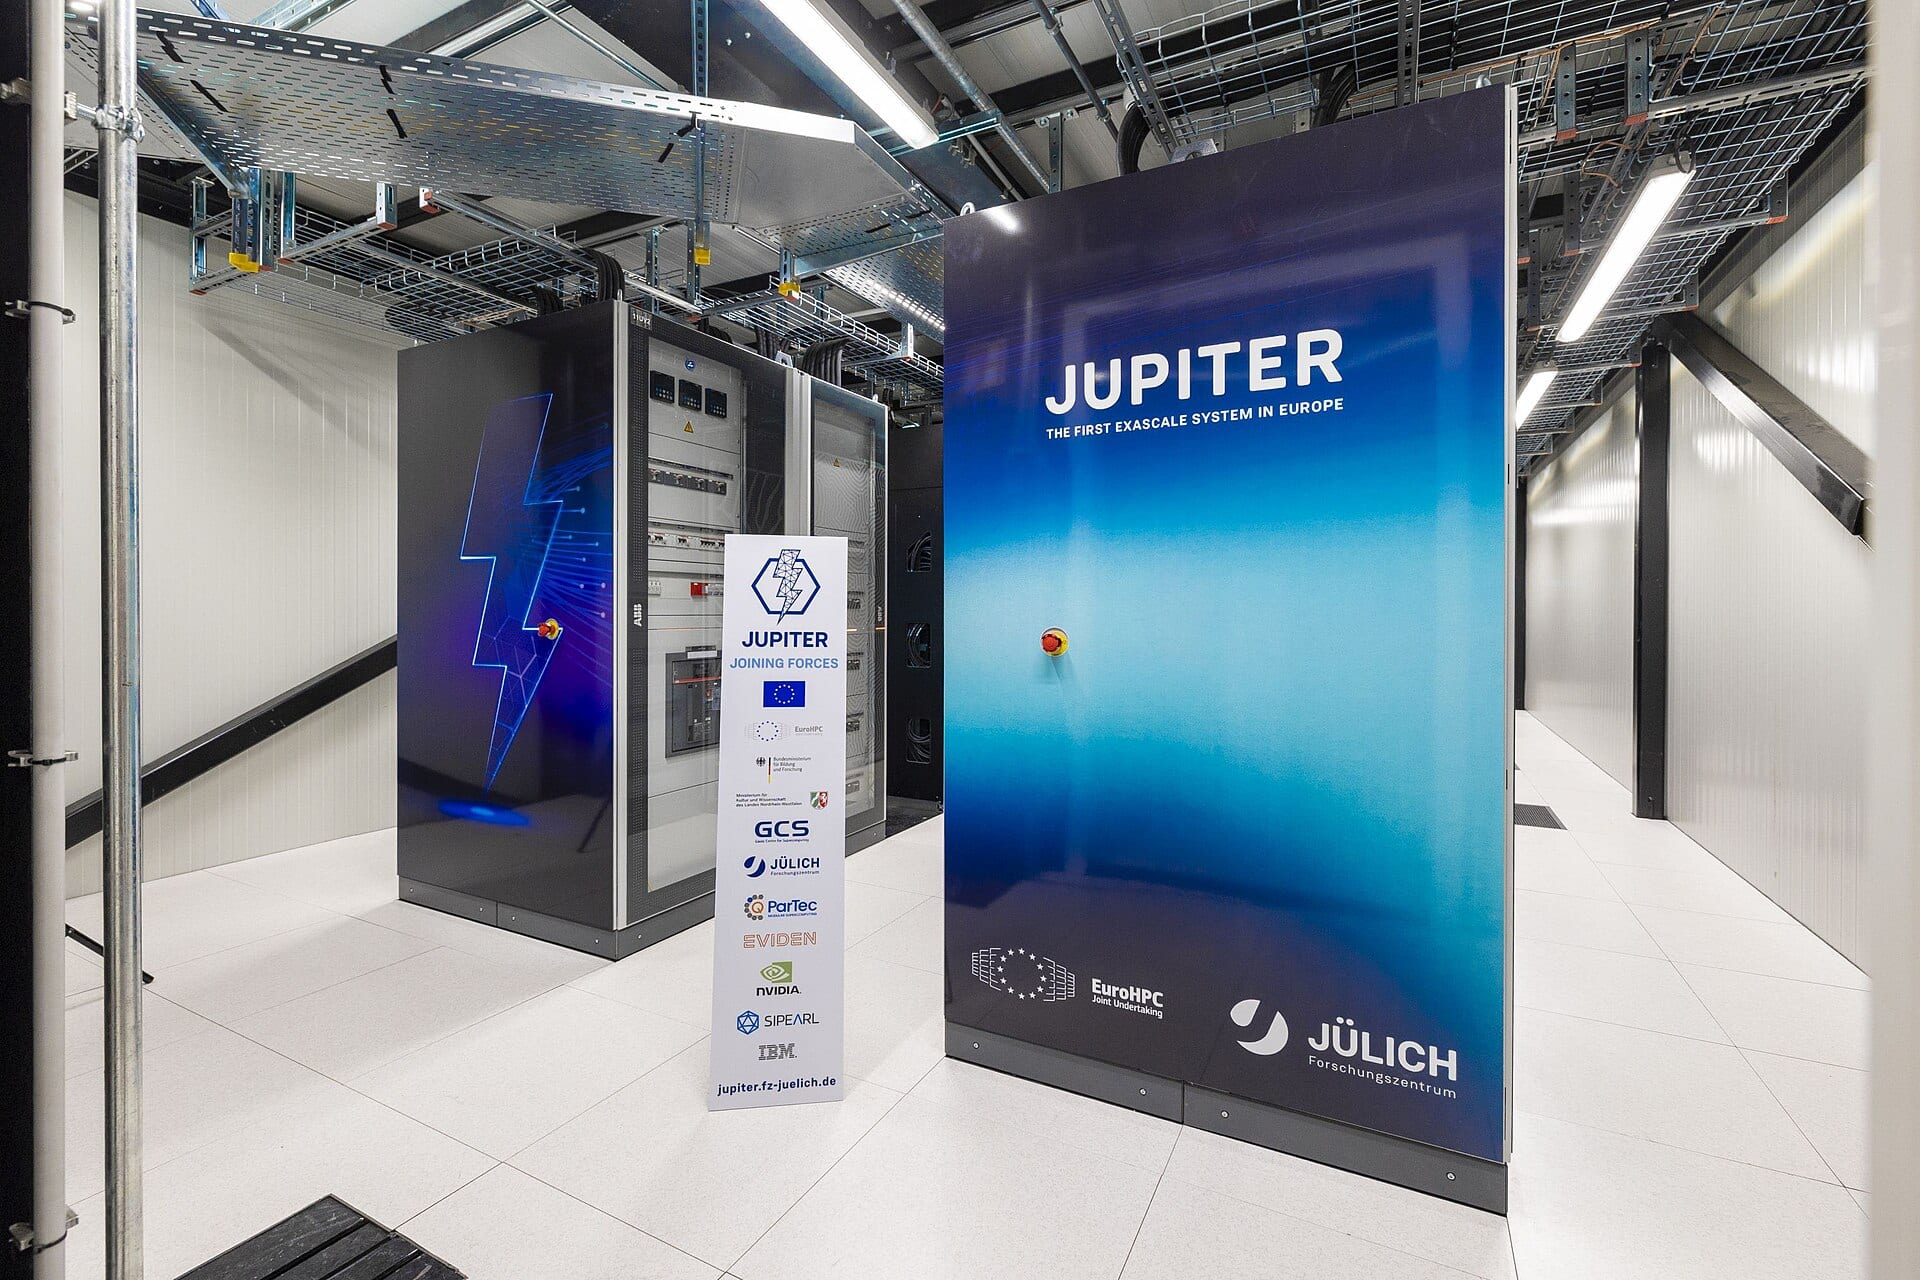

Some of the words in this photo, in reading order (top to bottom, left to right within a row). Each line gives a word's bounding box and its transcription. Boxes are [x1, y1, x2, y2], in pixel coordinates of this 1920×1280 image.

[1045, 328, 1344, 415] JUPITER
[1046, 427, 1071, 440] THE
[1074, 422, 1112, 437] FIRST
[1115, 414, 1188, 433] EXASCALE
[1191, 407, 1253, 425] SYSTEM
[1258, 405, 1274, 418] IN
[1279, 398, 1344, 416] EUROPE
[633, 603, 642, 627] ABB
[742, 631, 828, 648] JUPITER
[729, 657, 784, 669] JOINING
[787, 657, 839, 669] FORCES
[794, 725, 823, 733] EuroHPC
[755, 820, 810, 838] GCS
[770, 855, 820, 870] JÜLICH
[768, 899, 818, 913] ParTec
[743, 931, 817, 949] EVIDEN
[1091, 977, 1164, 1008] EuroHPC
[1092, 994, 1112, 1007] Joint
[1113, 999, 1163, 1019] Undertaking
[764, 1013, 820, 1027] SIPEARL
[758, 1043, 796, 1061] IBM
[1308, 1016, 1457, 1081] JÜLICH
[717, 1076, 837, 1096] jupiter.fz-juelich.de
[1308, 1055, 1457, 1099] Forschungszentrum
